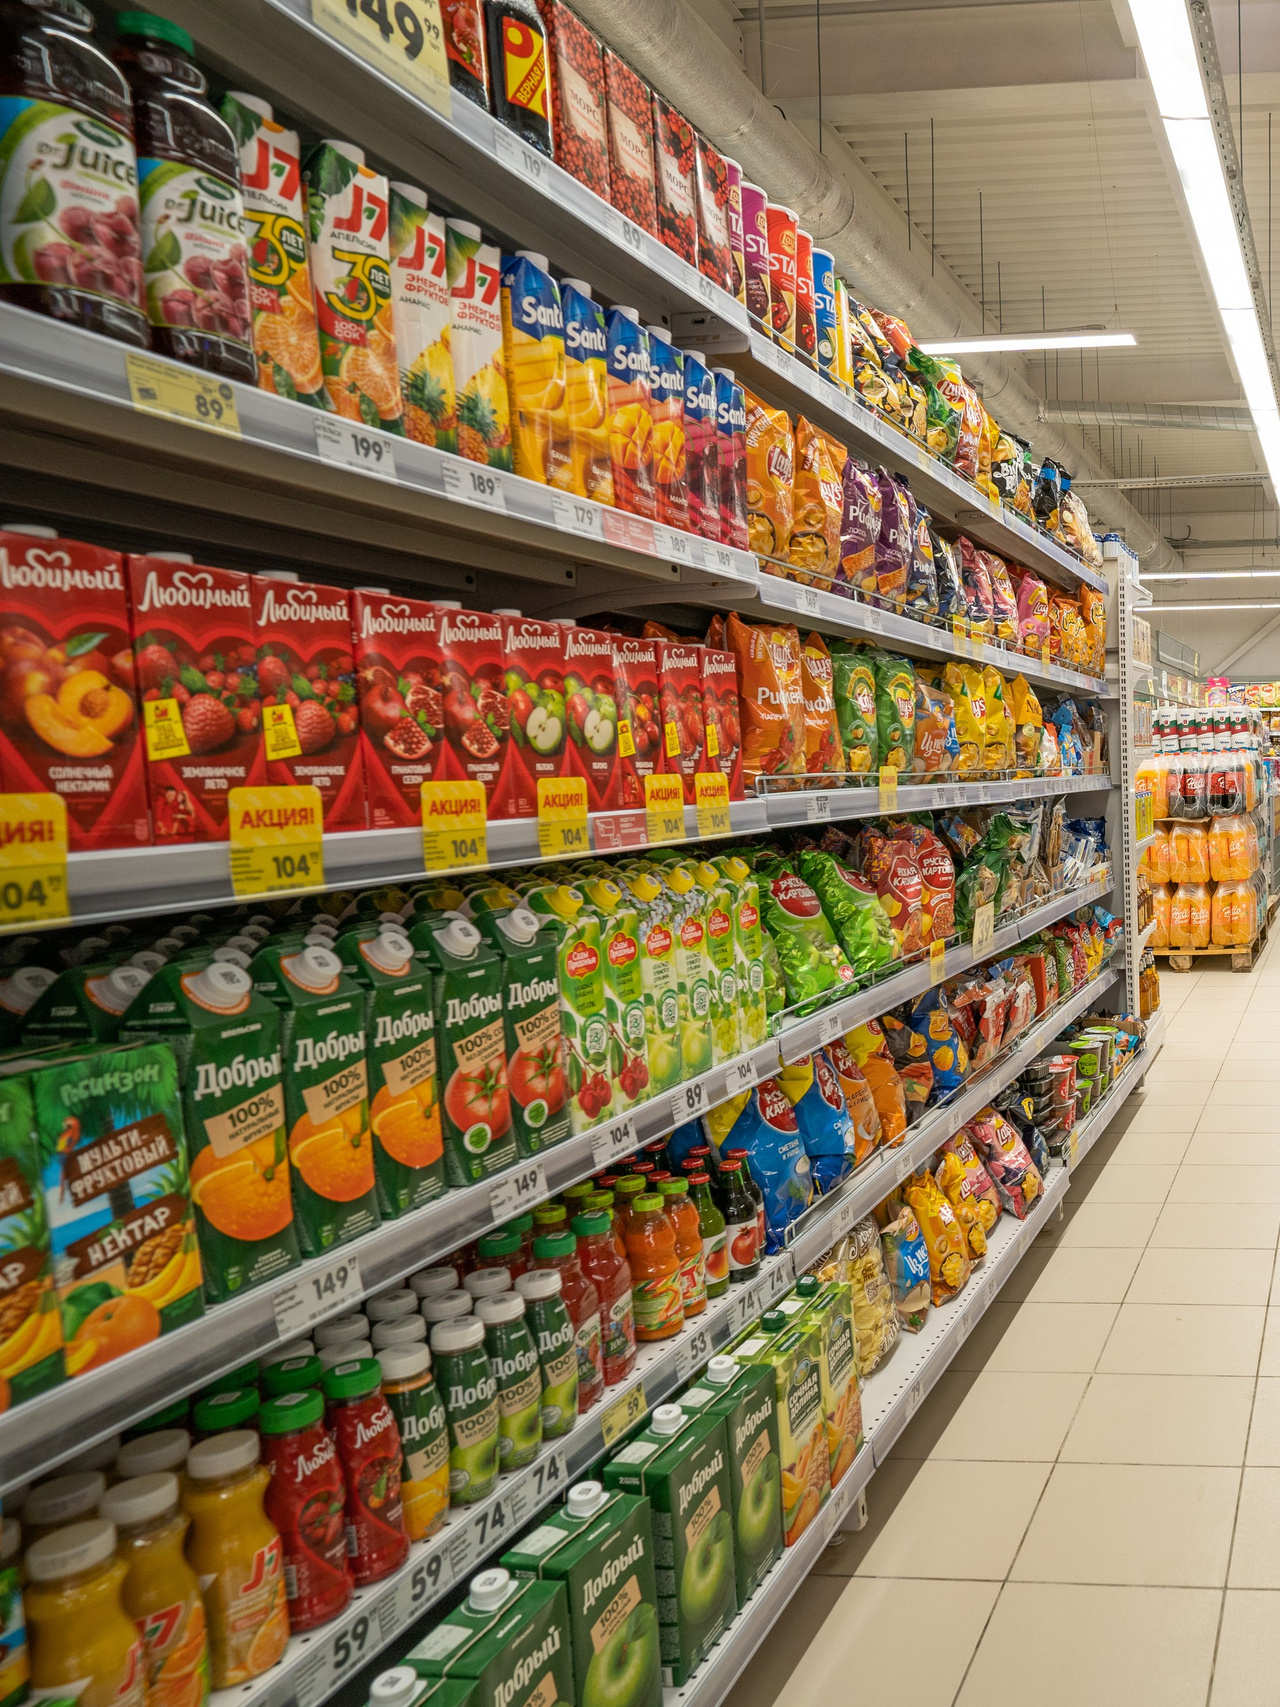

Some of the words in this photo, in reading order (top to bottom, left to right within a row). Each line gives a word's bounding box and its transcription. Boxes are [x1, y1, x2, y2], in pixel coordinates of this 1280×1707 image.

[424, 18, 440, 39] 99
[515, 64, 541, 104] ВЕРНАЯ
[333, 183, 389, 242] J7
[622, 221, 641, 249] 89
[397, 225, 447, 279] J7
[451, 256, 501, 306] J7
[195, 394, 224, 420] 89
[351, 433, 384, 463] 199
[469, 472, 495, 497] 189
[573, 504, 594, 527] 179
[669, 535, 686, 554] 189
[716, 549, 731, 567] 189
[137, 570, 252, 612] Любимый
[256, 588, 350, 627] Любимый
[359, 603, 437, 639] Любимый
[438, 615, 503, 647] Любимый
[504, 624, 561, 653] Любимый
[563, 633, 612, 660] Любимый
[661, 648, 698, 673] Любимый
[703, 654, 736, 678] Любимый
[543, 792, 584, 810] АКЦИЯ!
[649, 787, 681, 802] АКЦИЯ!
[700, 784, 728, 798] АКЦИЯ!
[239, 808, 315, 830] АКЦИЯ!
[429, 798, 481, 817] АКЦИЯ!
[711, 812, 726, 829] 104
[816, 799, 828, 813] 149
[561, 828, 583, 846] 104
[663, 818, 680, 835] 104
[452, 838, 478, 859] 104
[272, 854, 311, 879] 104
[612, 940, 628, 951] Сады
[650, 932, 665, 942] Сады
[978, 919, 992, 943] 39
[572, 951, 589, 961] Сады
[507, 977, 558, 1010] Добры
[445, 992, 502, 1029] Добры
[517, 1012, 549, 1037] 100%
[374, 1009, 434, 1047] Добры
[457, 1028, 494, 1057] 100%
[293, 1030, 367, 1072] Добры
[399, 1042, 432, 1073] 100%
[193, 1044, 282, 1101] Добры
[322, 1067, 362, 1099] 100%
[736, 1062, 753, 1081] 104
[227, 1093, 275, 1129] 100%
[685, 1083, 703, 1110] 89
[609, 1122, 631, 1145] 104
[70, 1134, 171, 1199] ФРУКТОВЫЙ
[512, 1171, 539, 1196] 149
[87, 1206, 171, 1267] НЕКТАР
[311, 1270, 349, 1299] 149
[768, 1268, 784, 1291] 74
[738, 1296, 755, 1319] 74
[690, 1331, 708, 1361] 53
[828, 1329, 852, 1362] СОЧНАЯ
[829, 1339, 852, 1373] ДОЛИНА
[787, 1373, 818, 1408] СОЧНАЯ
[789, 1384, 819, 1419] ДОЛИНА
[627, 1397, 640, 1414] 59
[735, 1396, 773, 1455] Добрый
[744, 1438, 763, 1468] 100%
[532, 1460, 560, 1496] 74
[678, 1449, 724, 1516] Добрый
[474, 1500, 506, 1545] 74
[690, 1495, 712, 1527] 100%
[411, 1555, 442, 1602] 59
[583, 1533, 645, 1616] Добрый
[598, 1588, 630, 1628] 100%
[333, 1617, 371, 1670] 59
